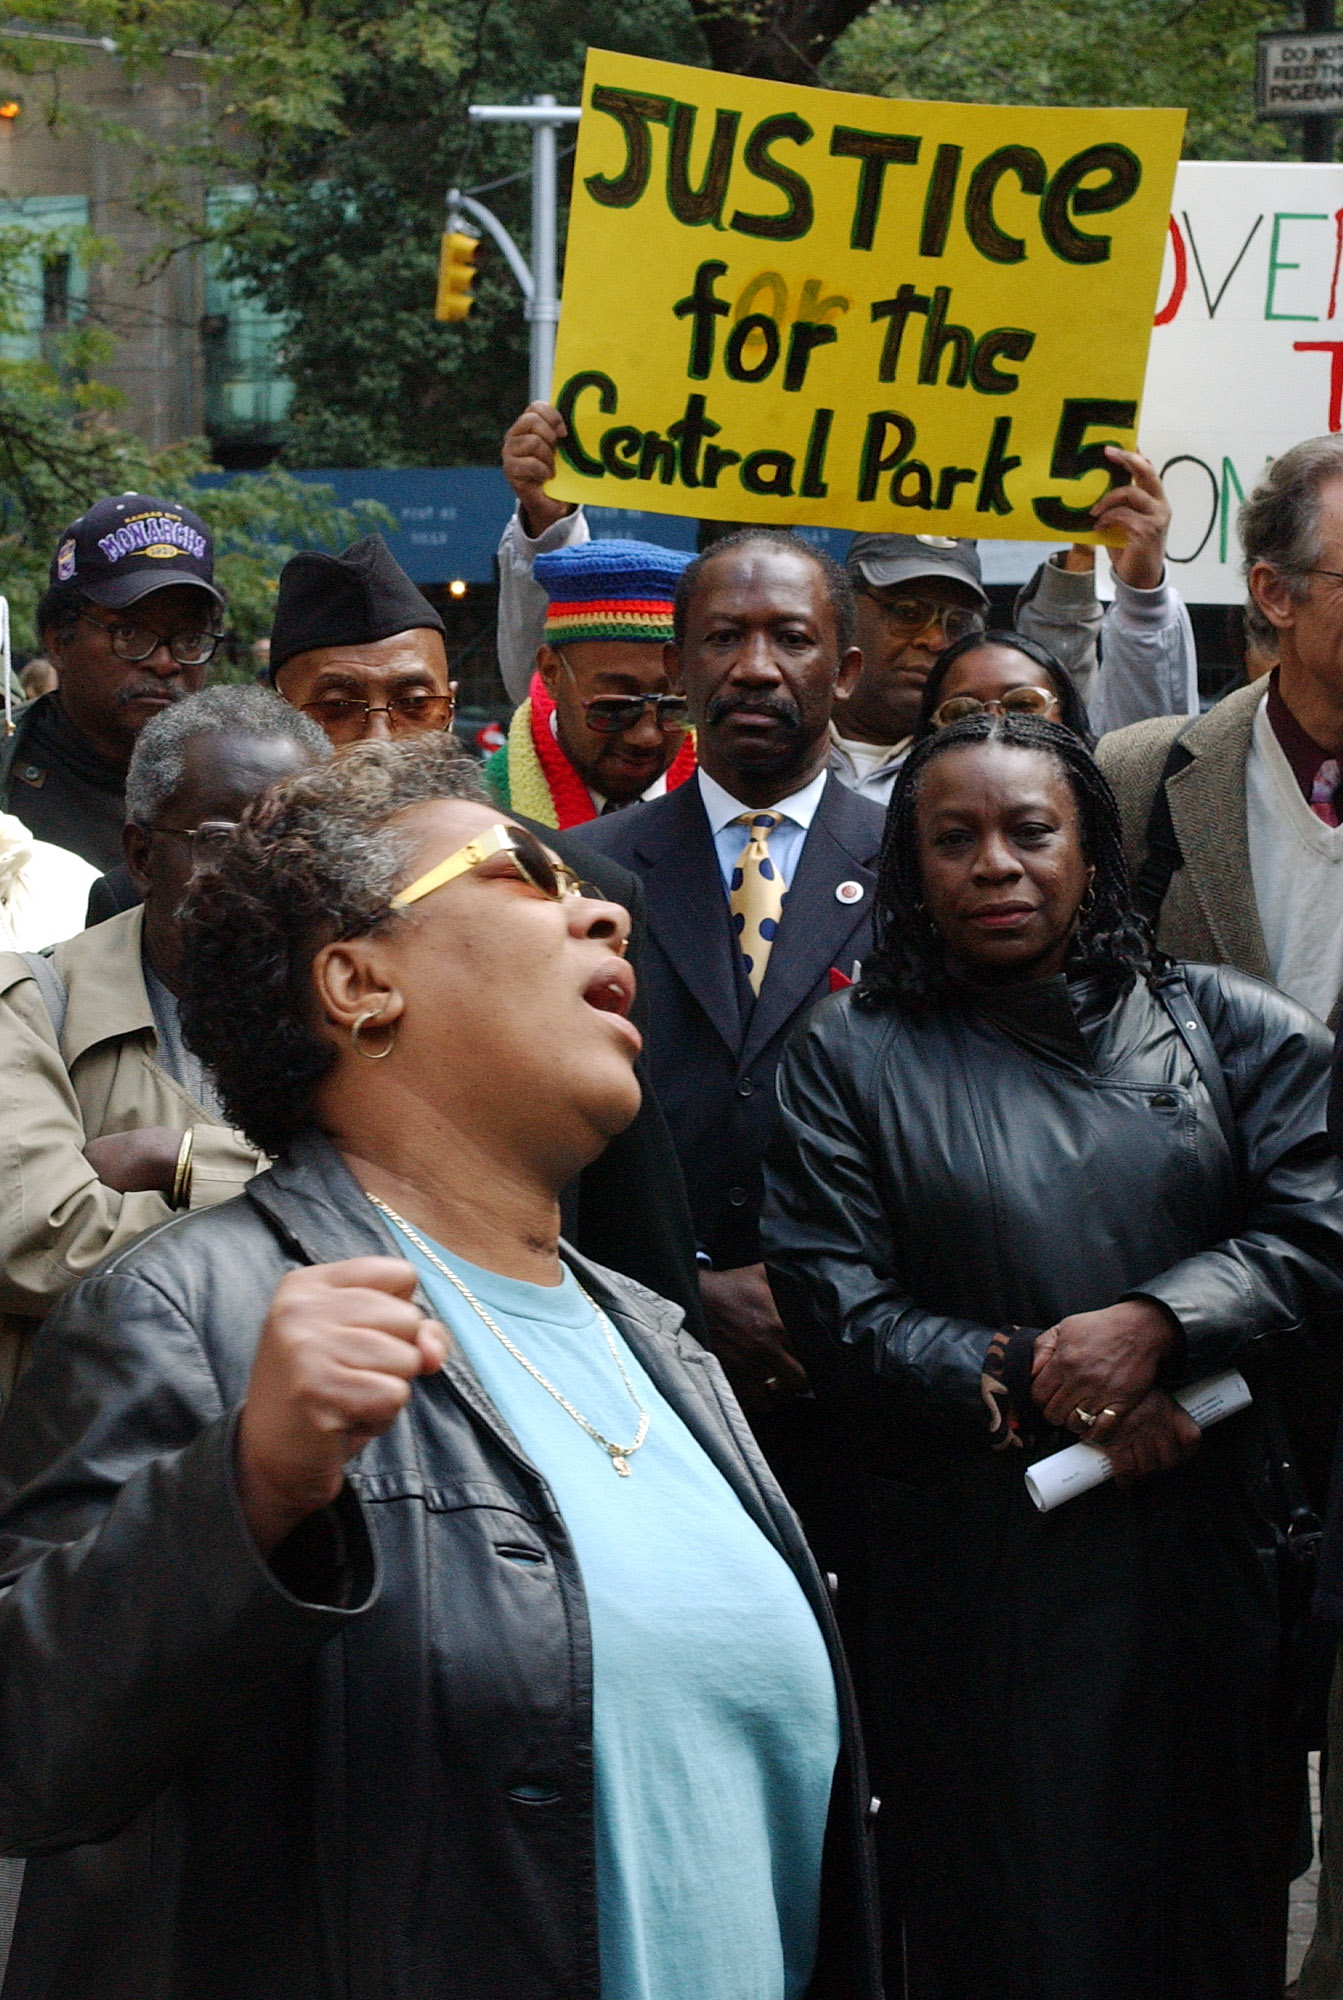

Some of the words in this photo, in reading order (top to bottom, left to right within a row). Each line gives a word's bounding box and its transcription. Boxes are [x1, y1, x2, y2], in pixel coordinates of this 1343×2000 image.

[1282, 47, 1307, 62] DO
[672, 259, 837, 392] for
[556, 370, 834, 498] Central
[857, 410, 1022, 516] Park
[1031, 398, 1138, 532] 5
[97, 517, 206, 563] MONARCHS
